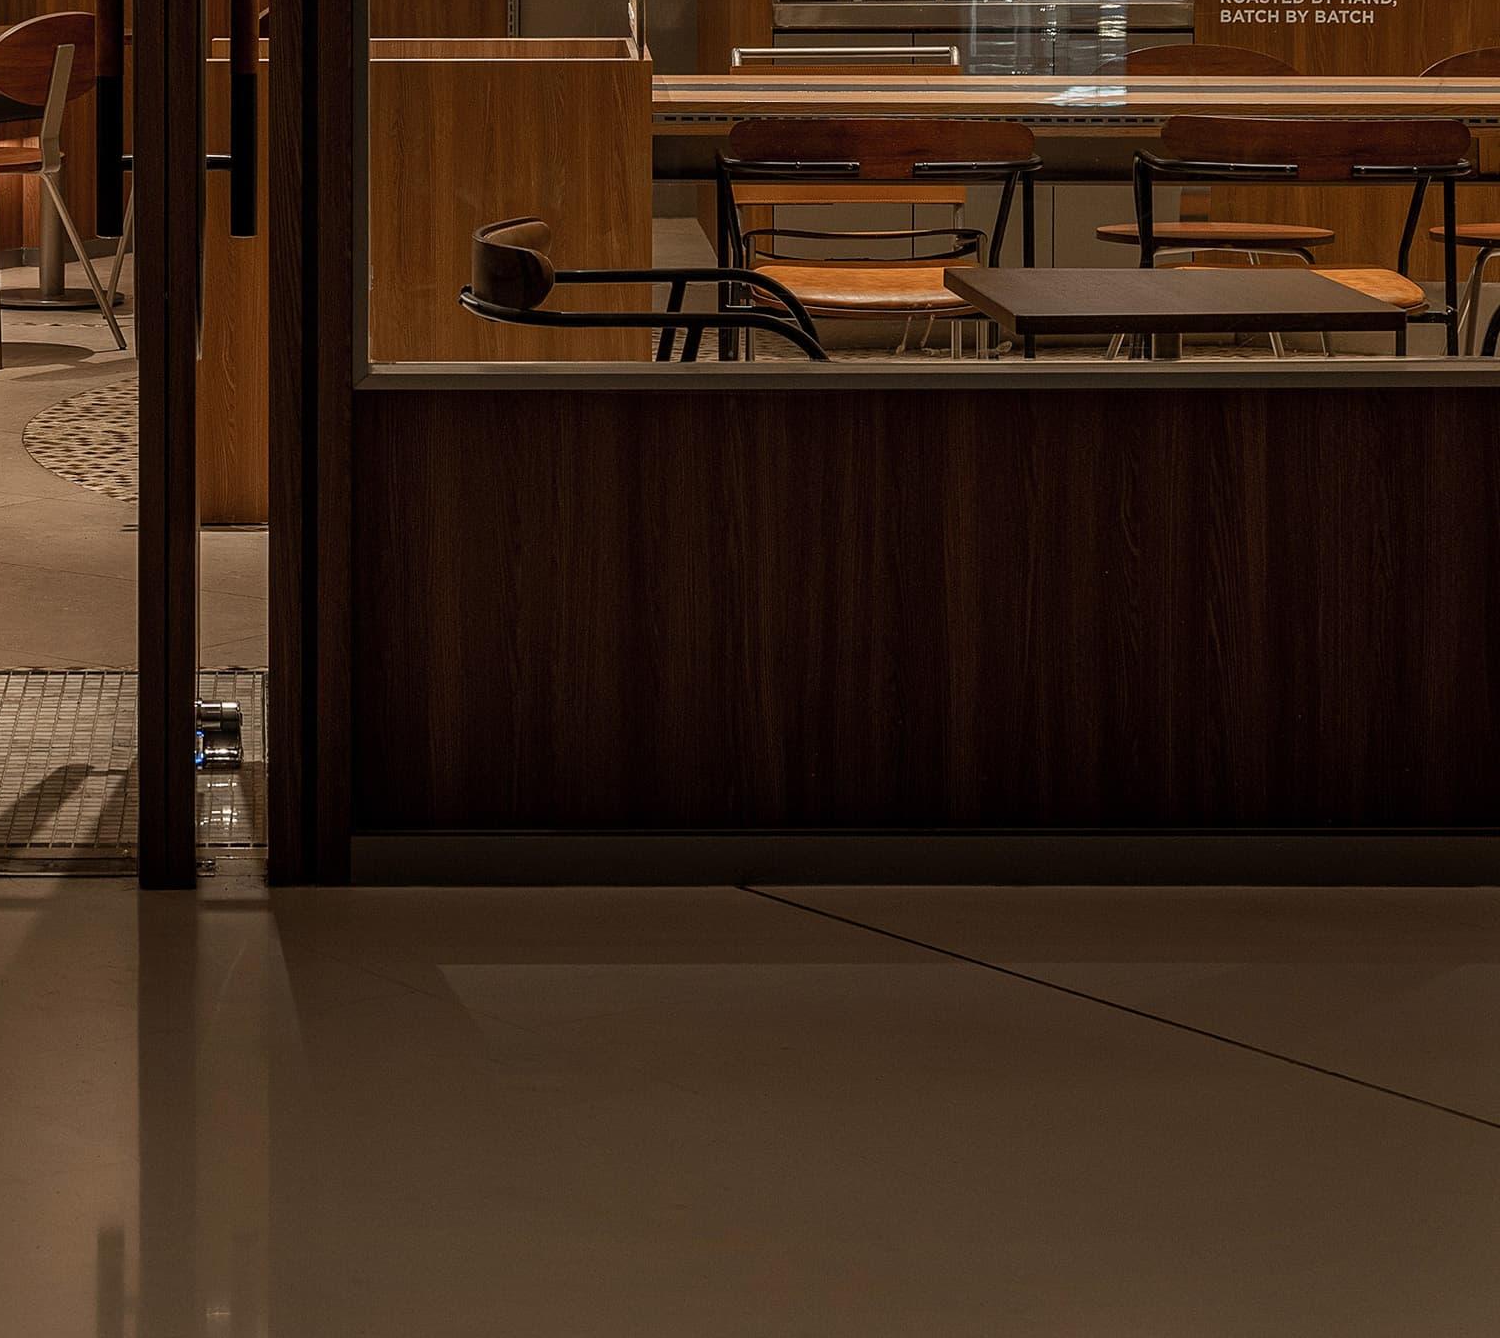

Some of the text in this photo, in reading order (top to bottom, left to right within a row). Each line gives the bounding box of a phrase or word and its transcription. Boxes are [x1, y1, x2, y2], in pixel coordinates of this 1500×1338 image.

[1220, 9, 1375, 24] BATCH BY BATCH
